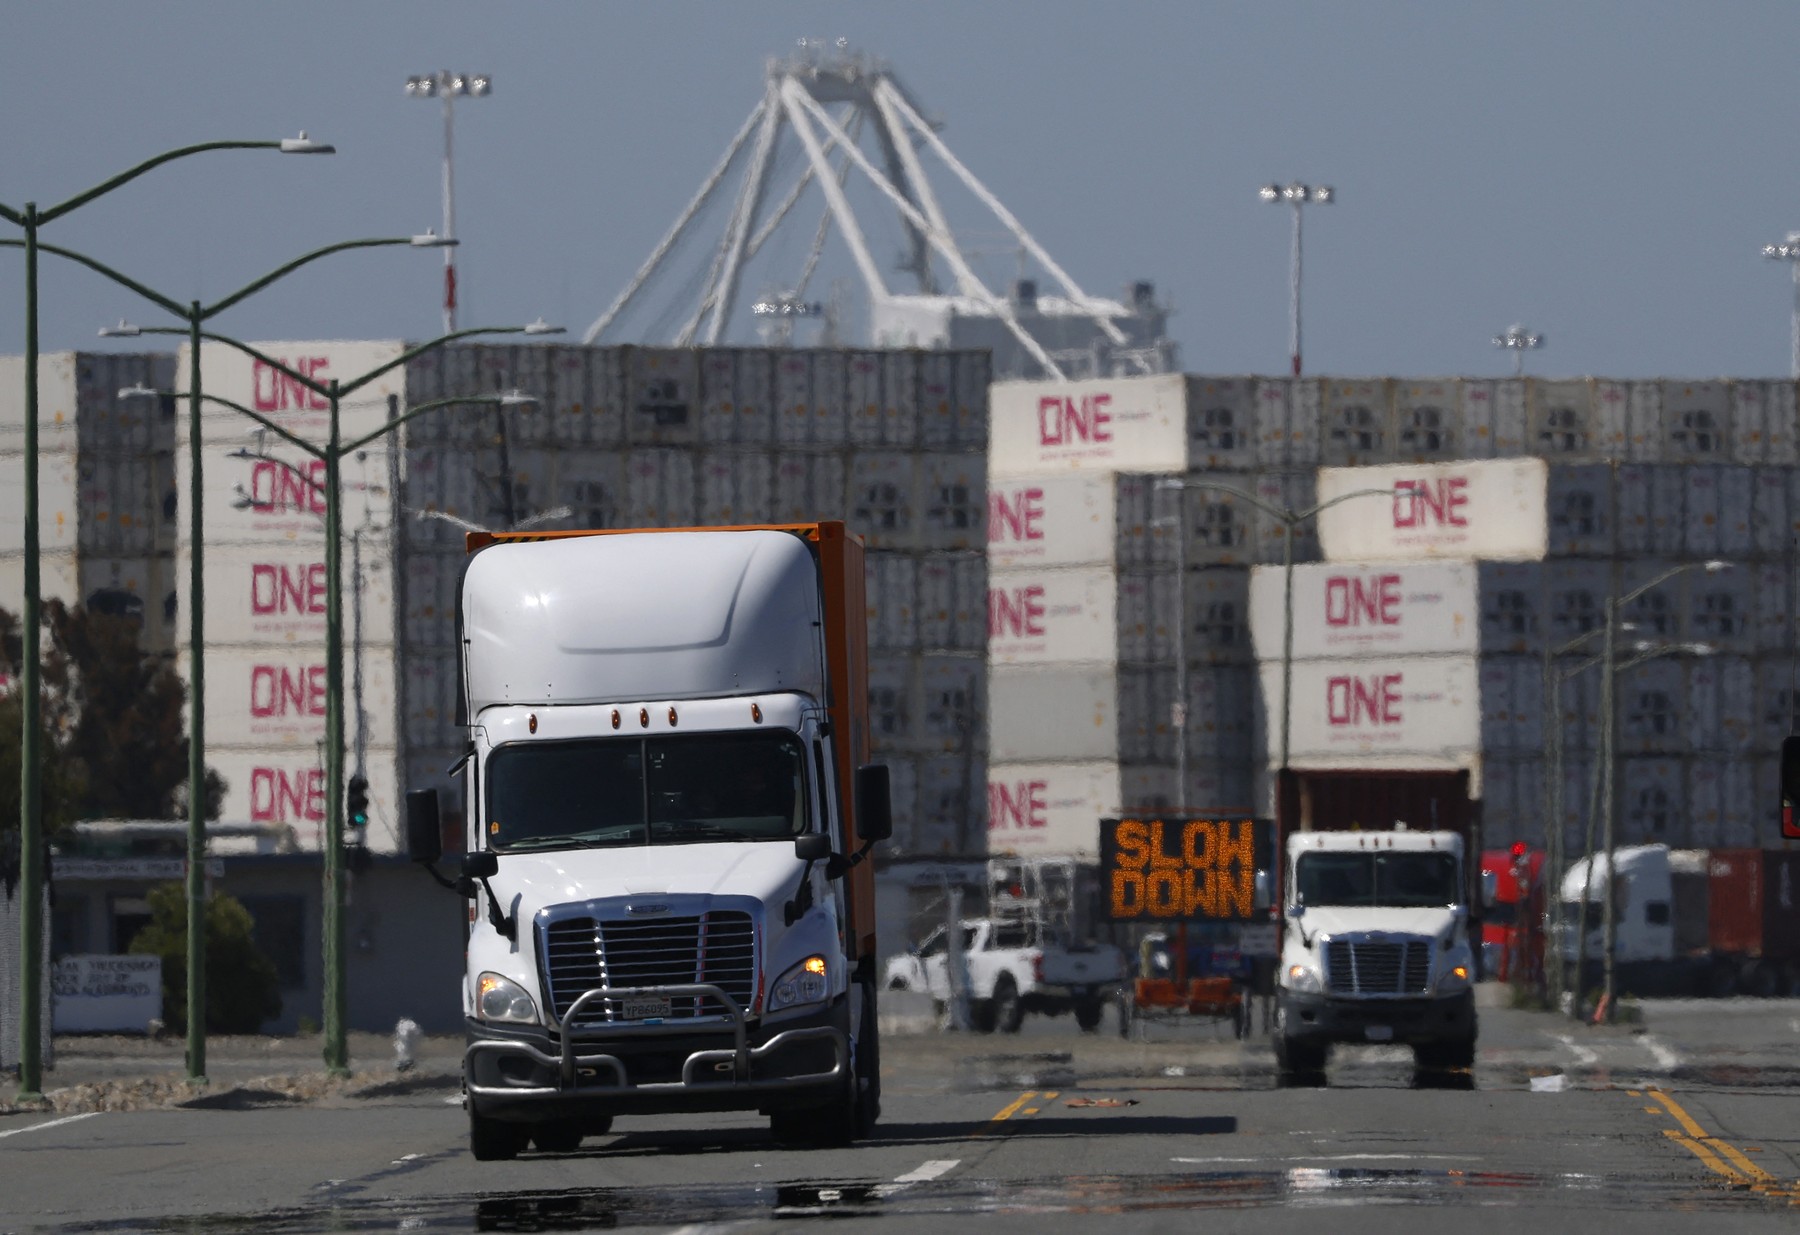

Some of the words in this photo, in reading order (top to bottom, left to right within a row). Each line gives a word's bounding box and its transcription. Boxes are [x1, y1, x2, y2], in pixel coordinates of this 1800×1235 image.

[254, 357, 329, 412] ONE
[1040, 394, 1112, 445] ONE
[253, 458, 326, 514] ONE
[1393, 478, 1468, 528] ONE
[252, 563, 326, 615] ONE
[1326, 575, 1401, 626] ONE
[251, 666, 326, 717] ONE
[1328, 673, 1402, 725] ONE
[251, 767, 326, 822] ONE
[1115, 819, 1254, 871] SLOW
[1110, 869, 1254, 918] DOWN
